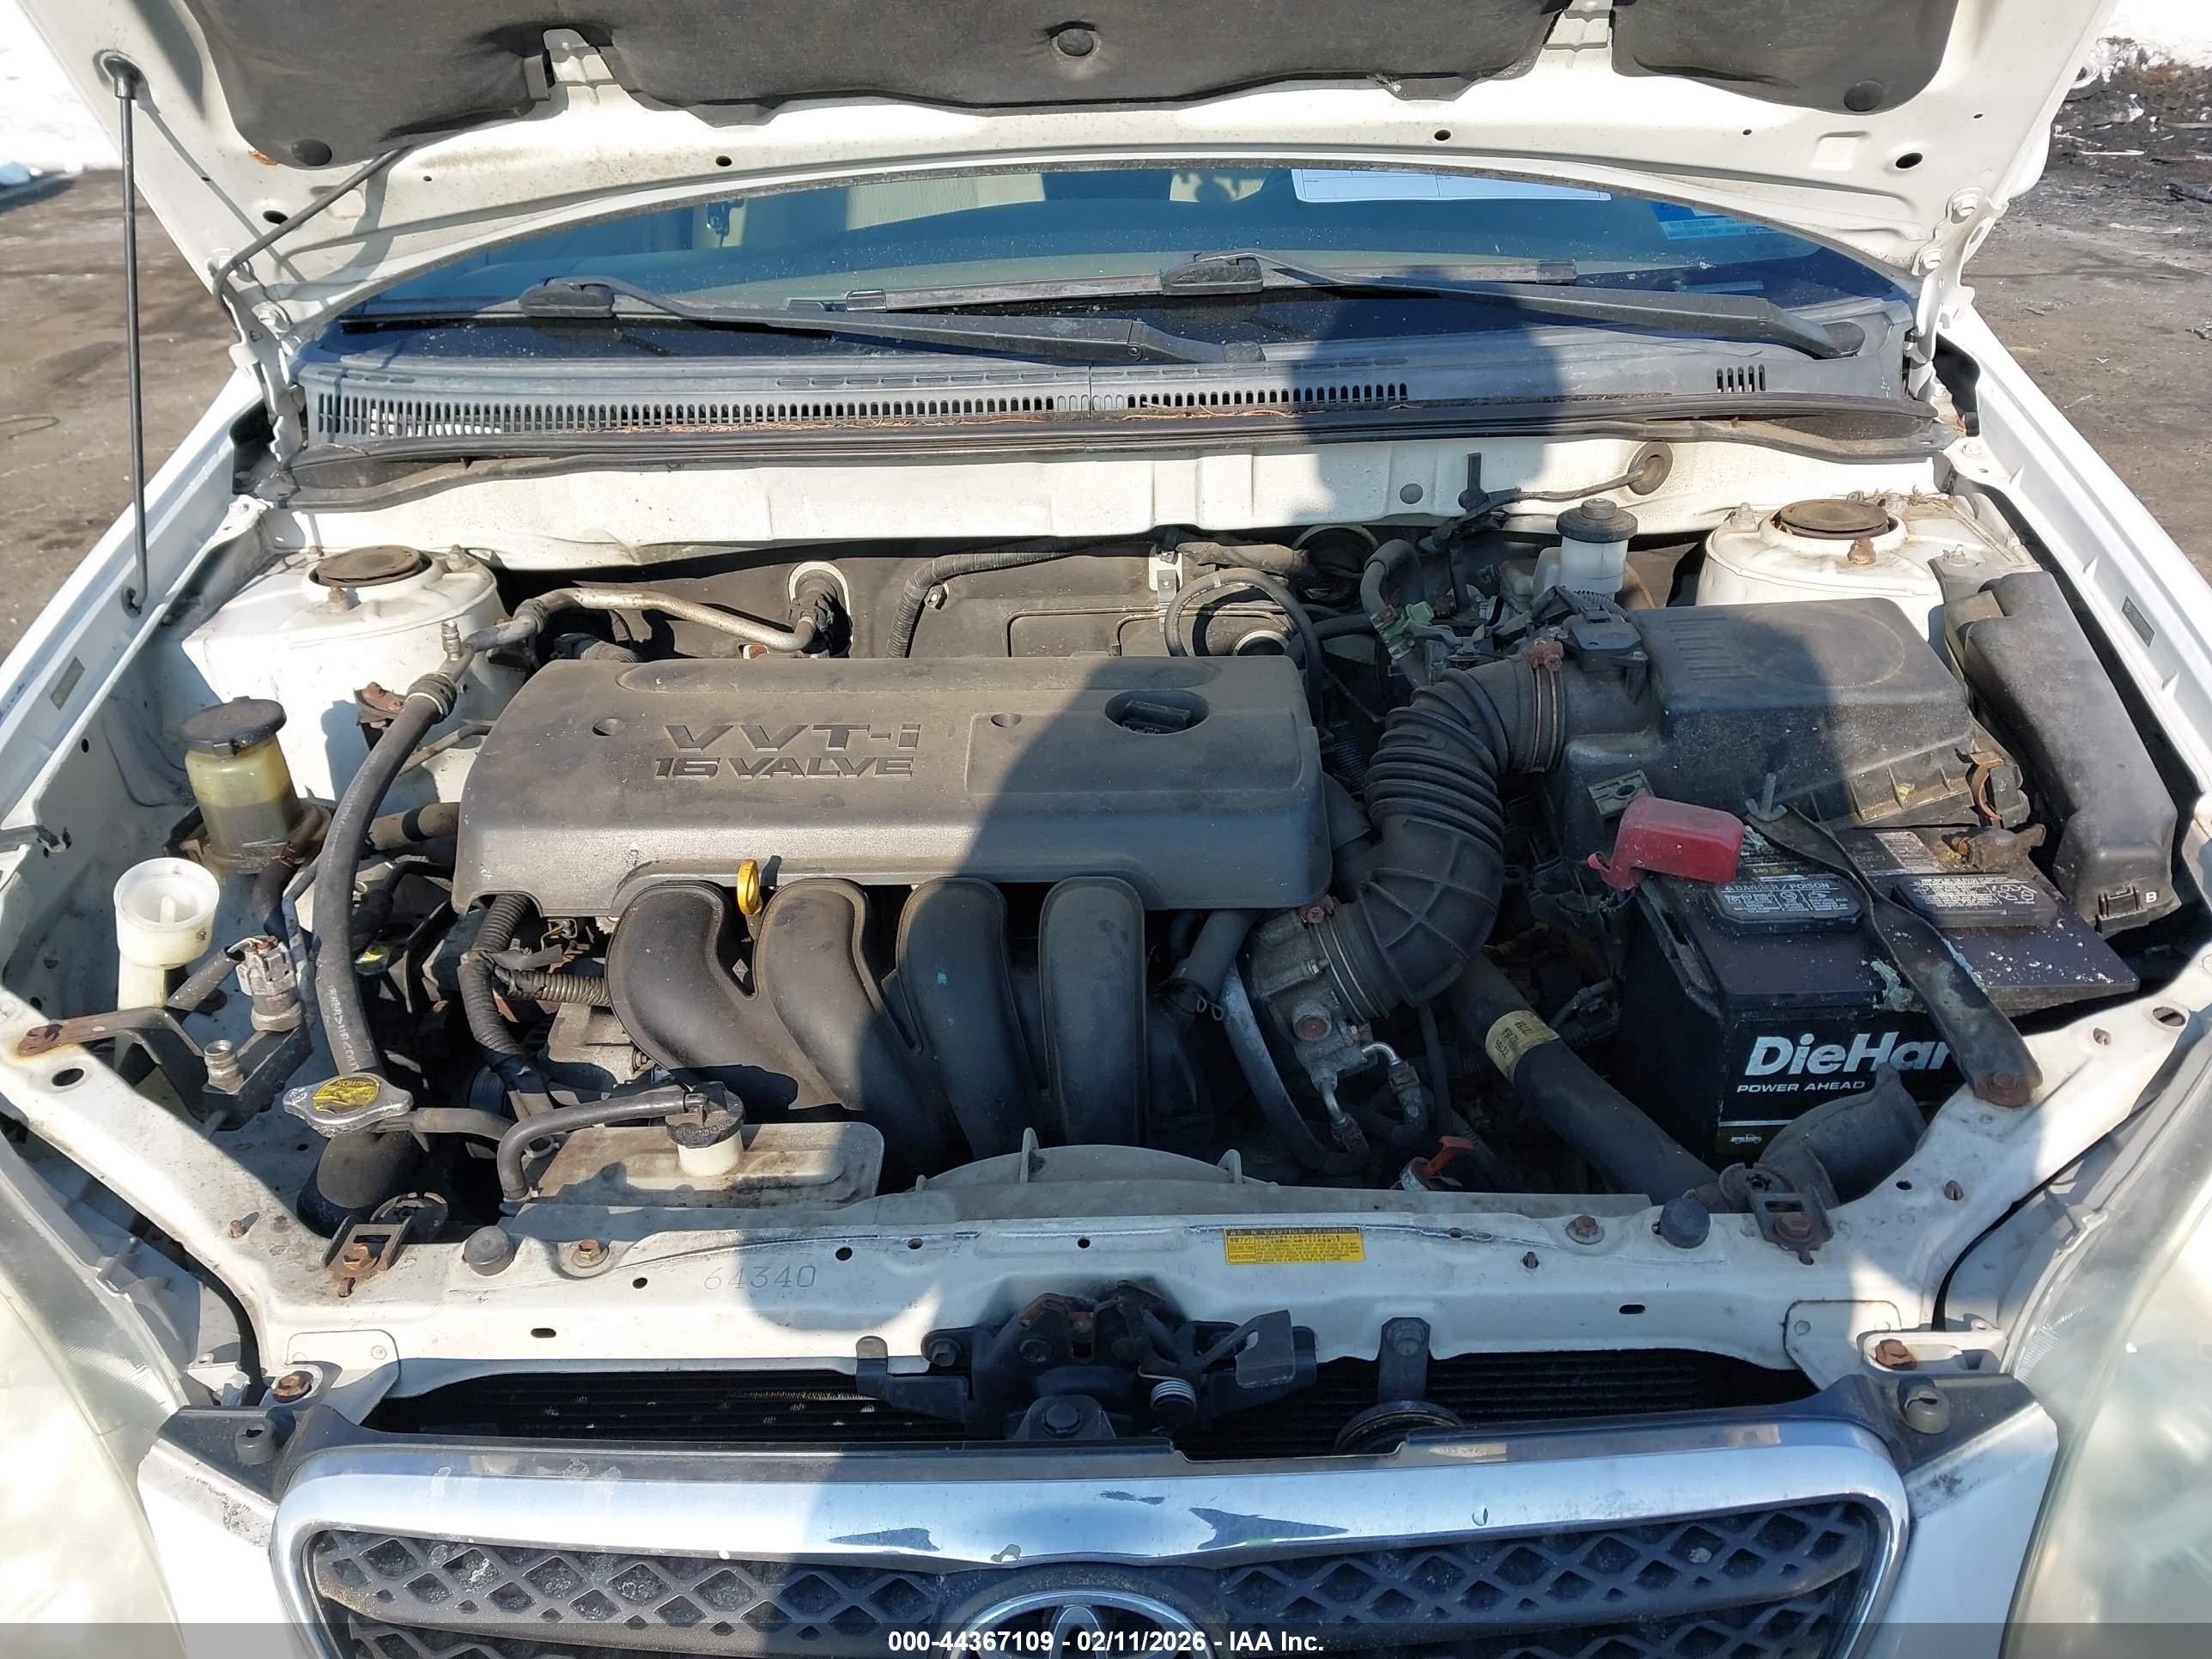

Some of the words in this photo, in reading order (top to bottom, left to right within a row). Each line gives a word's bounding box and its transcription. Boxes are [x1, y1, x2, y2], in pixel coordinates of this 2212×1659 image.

[665, 724, 921, 751] VVT-i
[653, 757, 720, 779] 16
[727, 757, 914, 779] VALVE
[1735, 883, 1779, 891] DANGER
[2146, 891, 2157, 903] B
[1744, 1031, 1951, 1076] DieHar
[1736, 1082, 1799, 1093] POWER
[1804, 1080, 1866, 1091] AHEAD
[704, 1263, 817, 1290] 64340
